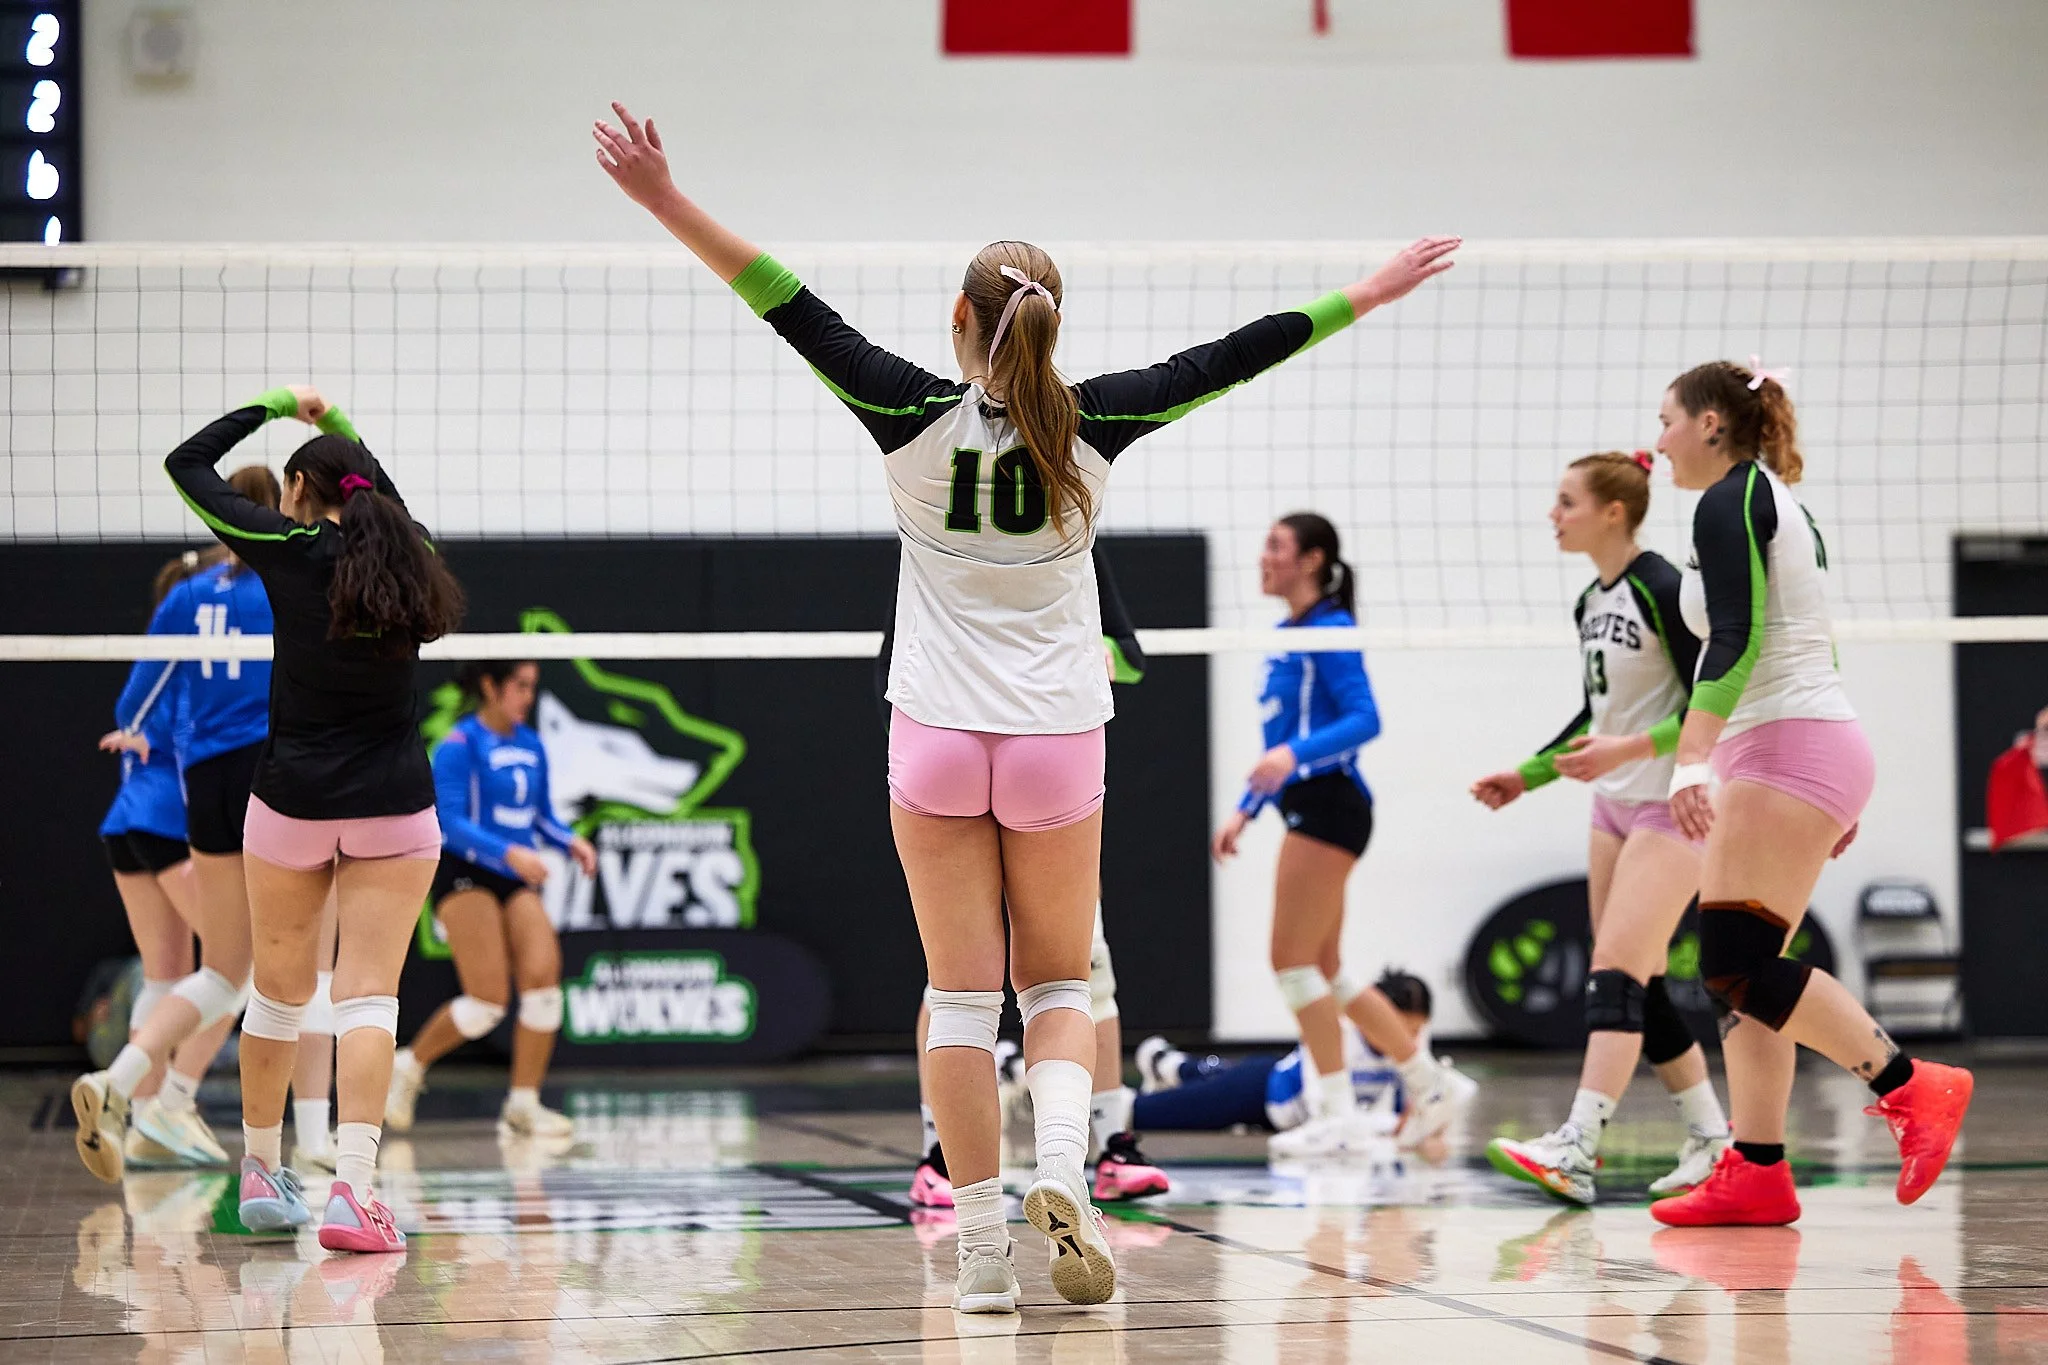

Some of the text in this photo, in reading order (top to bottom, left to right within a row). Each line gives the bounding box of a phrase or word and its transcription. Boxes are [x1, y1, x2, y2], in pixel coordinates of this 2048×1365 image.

[26, 13, 60, 66] 2
[27, 79, 61, 133] 2
[945, 444, 1048, 536] 10
